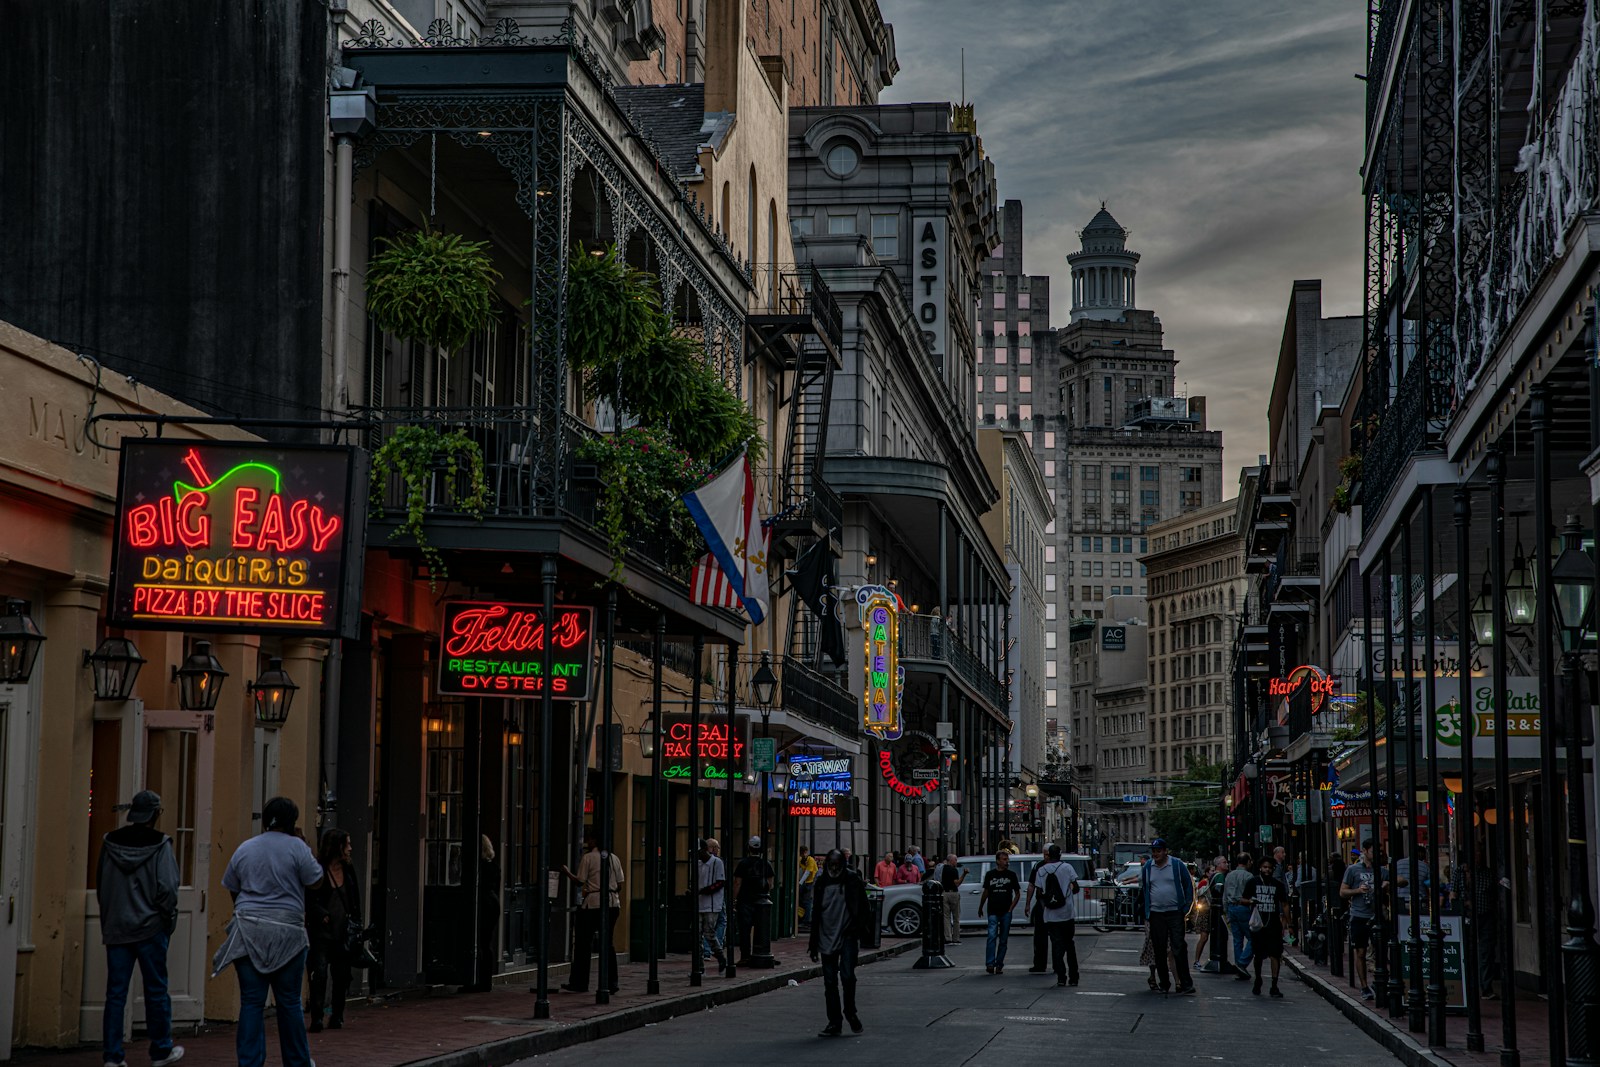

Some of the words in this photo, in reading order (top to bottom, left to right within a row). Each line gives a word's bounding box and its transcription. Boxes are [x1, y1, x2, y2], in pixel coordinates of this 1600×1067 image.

[920, 222, 937, 351] ASTOR
[128, 490, 210, 547] BIG
[232, 487, 341, 551] EASY
[133, 587, 186, 616] PIZZA
[193, 590, 220, 616] BY
[225, 591, 264, 618] THE
[267, 593, 324, 621] SLICE
[1106, 629, 1123, 638] AC
[449, 659, 582, 676] RESTAURNT
[871, 609, 889, 720] GATEWAY
[1268, 677, 1303, 695] Hard
[1310, 674, 1334, 696] ock
[1486, 719, 1516, 731] BR
[1519, 719, 1530, 731] &
[704, 765, 742, 778] Orlens
[791, 759, 850, 776] GATEWAY
[879, 750, 923, 798] BOURBON
[815, 780, 851, 791] COCKTAILS
[1331, 810, 1343, 818] EW
